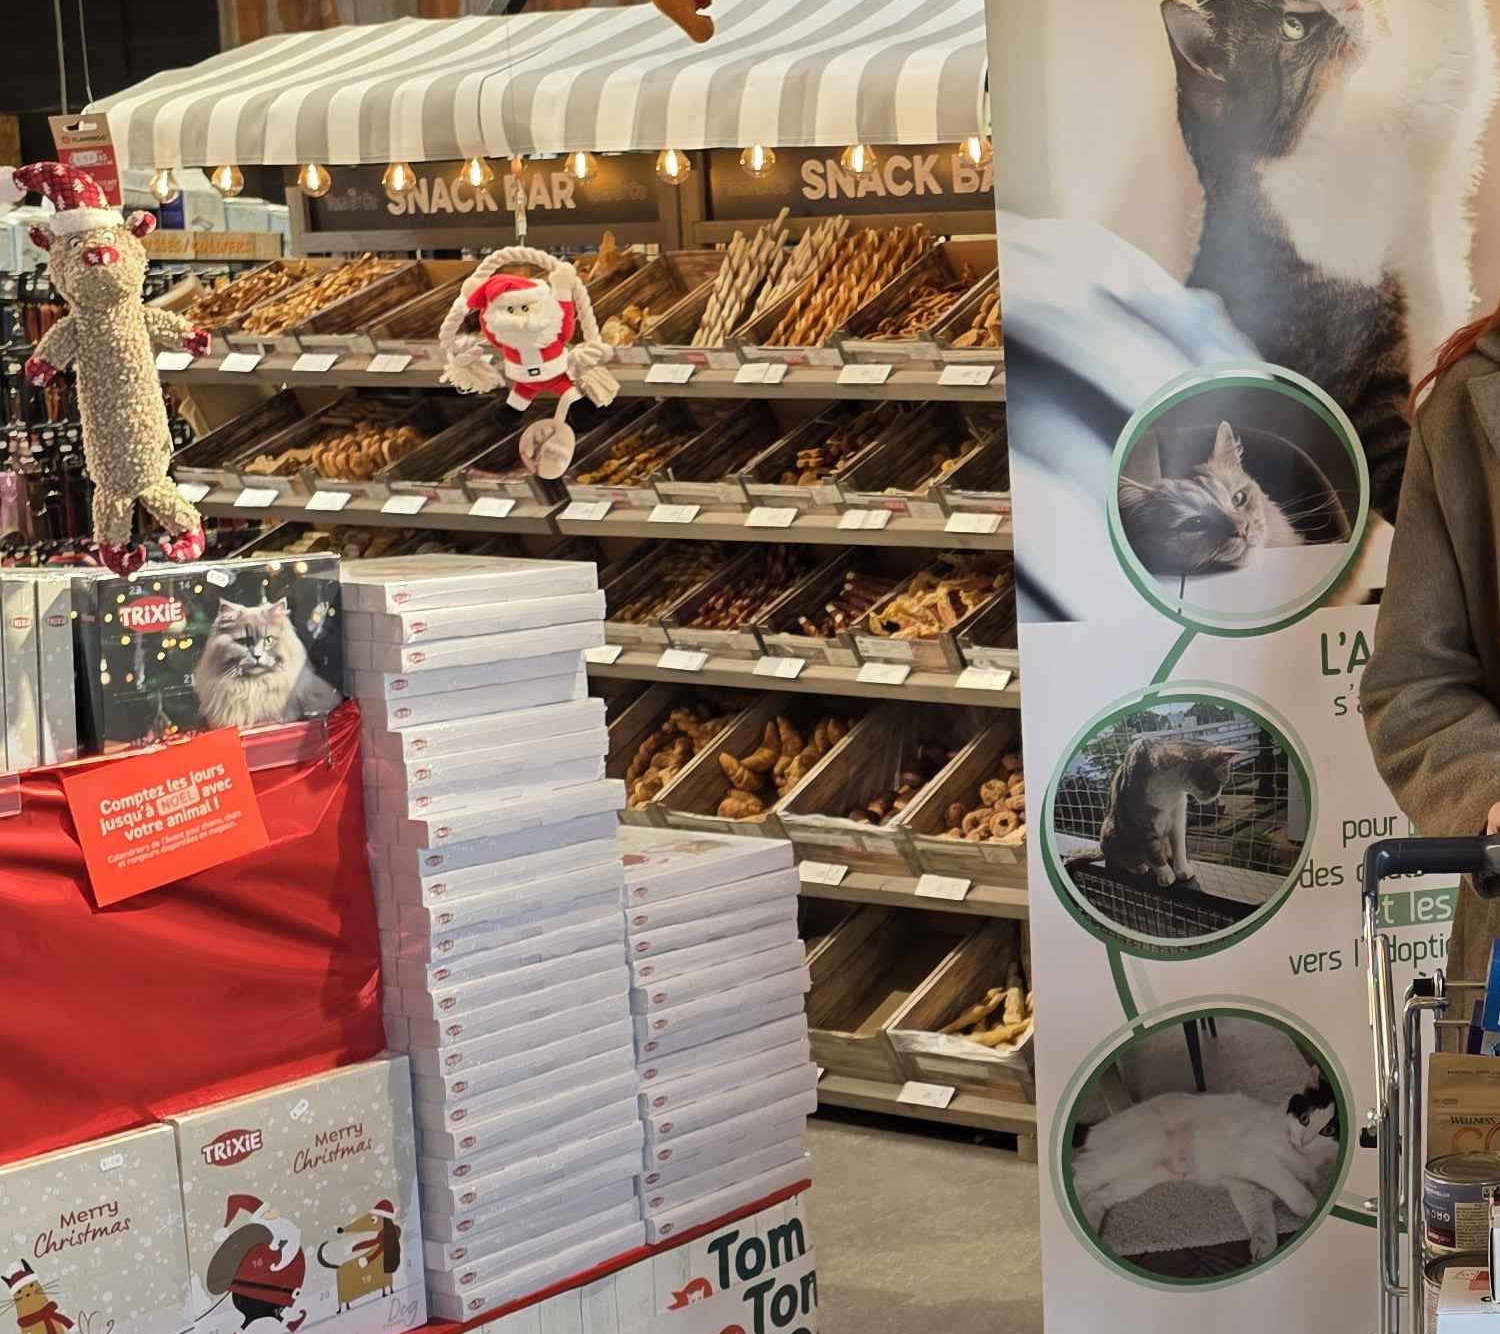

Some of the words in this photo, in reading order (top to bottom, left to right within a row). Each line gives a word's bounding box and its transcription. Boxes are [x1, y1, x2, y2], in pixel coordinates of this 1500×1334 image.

[801, 154, 943, 200] SNACK
[386, 178, 498, 216] SNACK
[504, 172, 577, 212] BAR
[119, 601, 183, 627] TRIXIE
[99, 785, 165, 816] Comptez
[165, 776, 188, 790] les
[202, 778, 233, 798] avec
[124, 820, 163, 842] votre
[166, 799, 212, 828] animal
[1342, 815, 1398, 848] pour
[1299, 864, 1344, 889] des
[1410, 893, 1452, 922] les
[1288, 949, 1342, 975] vers
[314, 1122, 364, 1148] Merry
[1450, 1115, 1496, 1126] WELLNESS
[200, 1130, 263, 1164] TRIXIE
[292, 1137, 374, 1174] Christmas
[59, 1200, 119, 1229] Merry
[33, 1216, 131, 1259] Christmas
[707, 1218, 807, 1290] Tom
[387, 1298, 418, 1326] Dog
